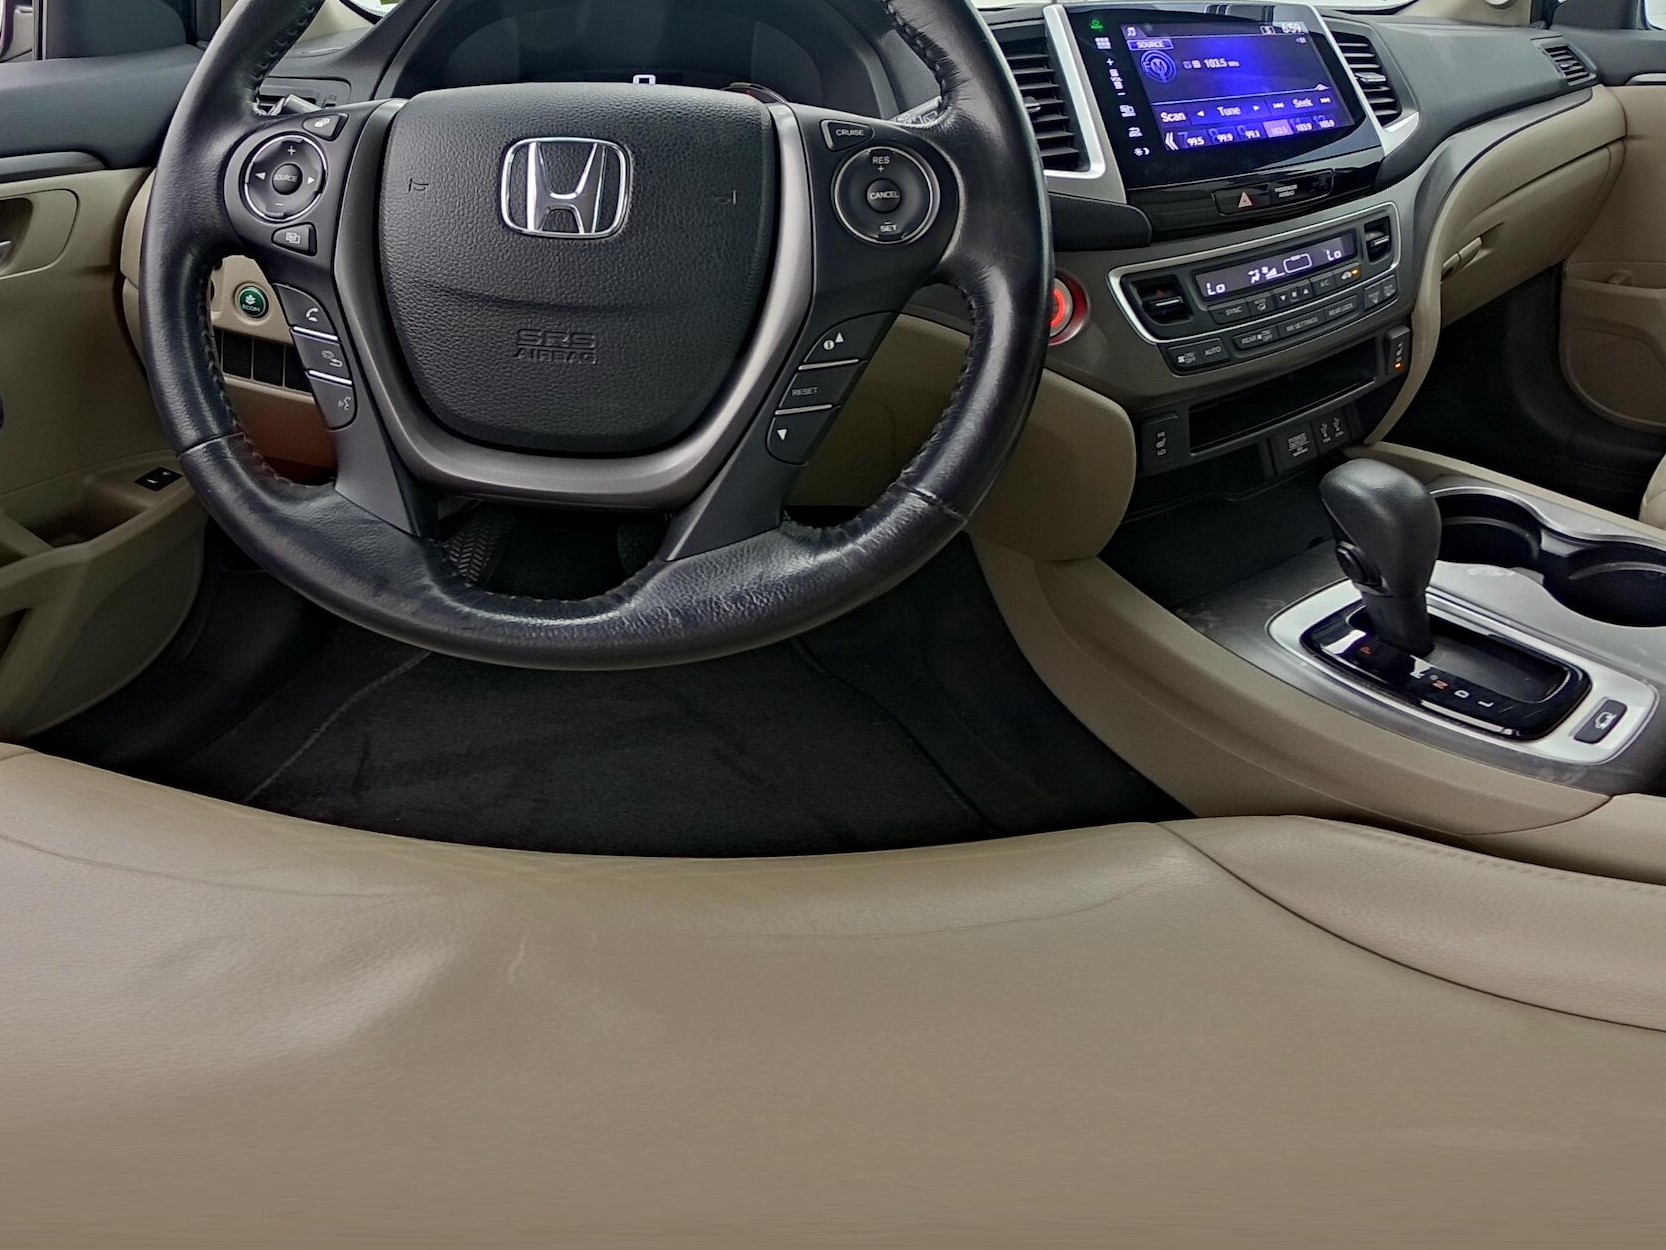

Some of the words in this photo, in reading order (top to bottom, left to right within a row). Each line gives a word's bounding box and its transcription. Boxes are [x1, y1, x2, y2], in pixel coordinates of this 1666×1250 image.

[1204, 57, 1228, 69] 103.5
[1292, 98, 1314, 109] Seek
[1217, 106, 1242, 117] Tune
[1161, 111, 1187, 123] Scan
[836, 129, 865, 137] CRUISE
[872, 155, 890, 165] RES
[870, 190, 900, 200] CANCEL
[879, 223, 898, 233] SET
[241, 303, 261, 313] ECON
[517, 328, 597, 350] SRS
[514, 347, 598, 365] AIRBAG
[791, 386, 819, 397] RESET
[1432, 680, 1449, 690] N
[1454, 689, 1470, 699] D
[1478, 700, 1494, 708] L
